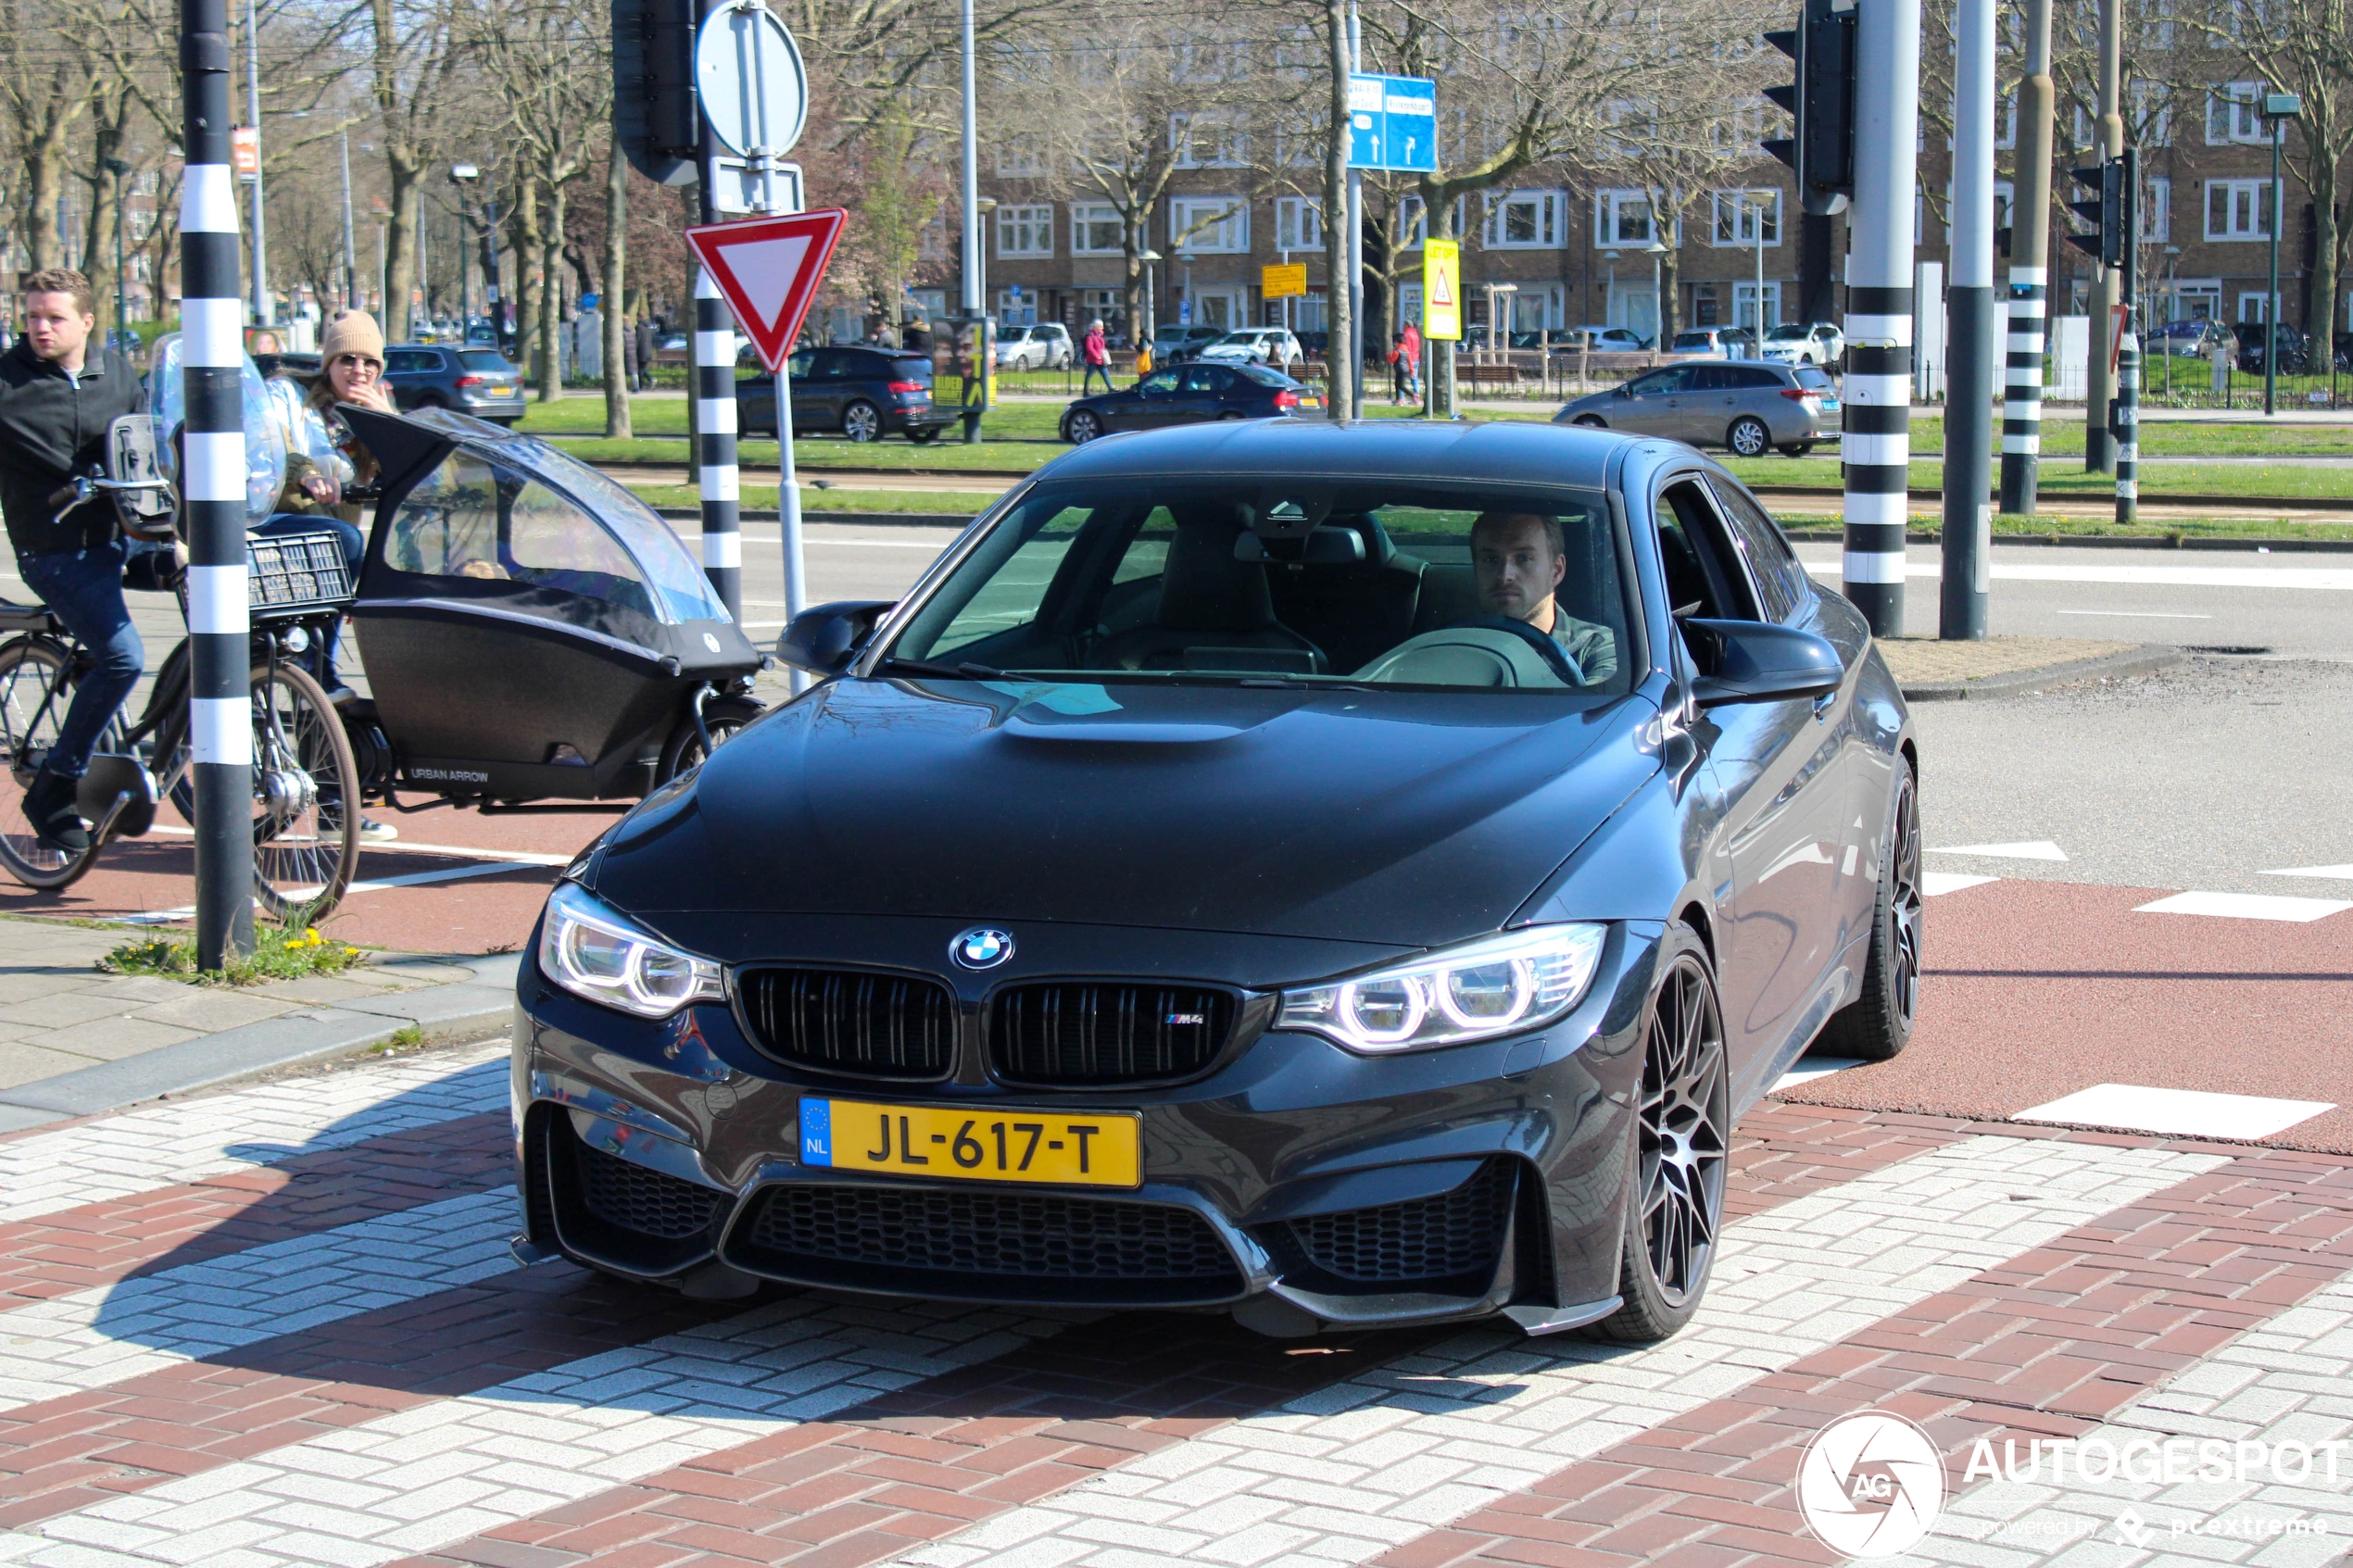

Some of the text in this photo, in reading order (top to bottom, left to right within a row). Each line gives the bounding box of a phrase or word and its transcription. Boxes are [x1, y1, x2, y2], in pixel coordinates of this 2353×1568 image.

[1389, 98, 1430, 112] Rivierenbuurt
[1429, 246, 1441, 258] LET
[935, 376, 963, 390] BLOED
[411, 768, 488, 783] URBAN ARROW
[965, 930, 1009, 944] BMW
[1176, 1014, 1203, 1024] M4
[806, 1138, 827, 1155] NL
[867, 1113, 1100, 1173] JL-617-T
